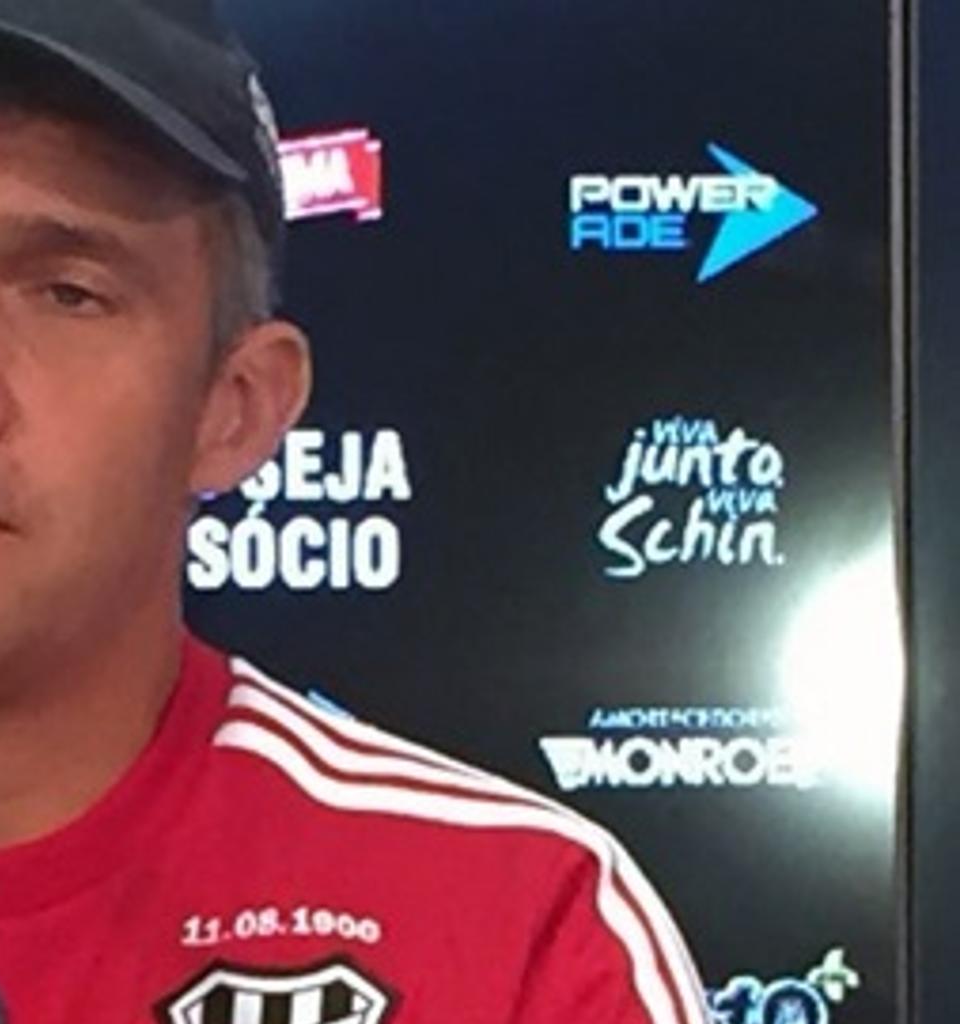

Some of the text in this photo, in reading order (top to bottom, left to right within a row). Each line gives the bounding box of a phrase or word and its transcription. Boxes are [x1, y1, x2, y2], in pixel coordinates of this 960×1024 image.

[569, 174, 782, 214] POWER
[571, 214, 688, 250] ADE
[187, 500, 401, 590] SÓCIO
